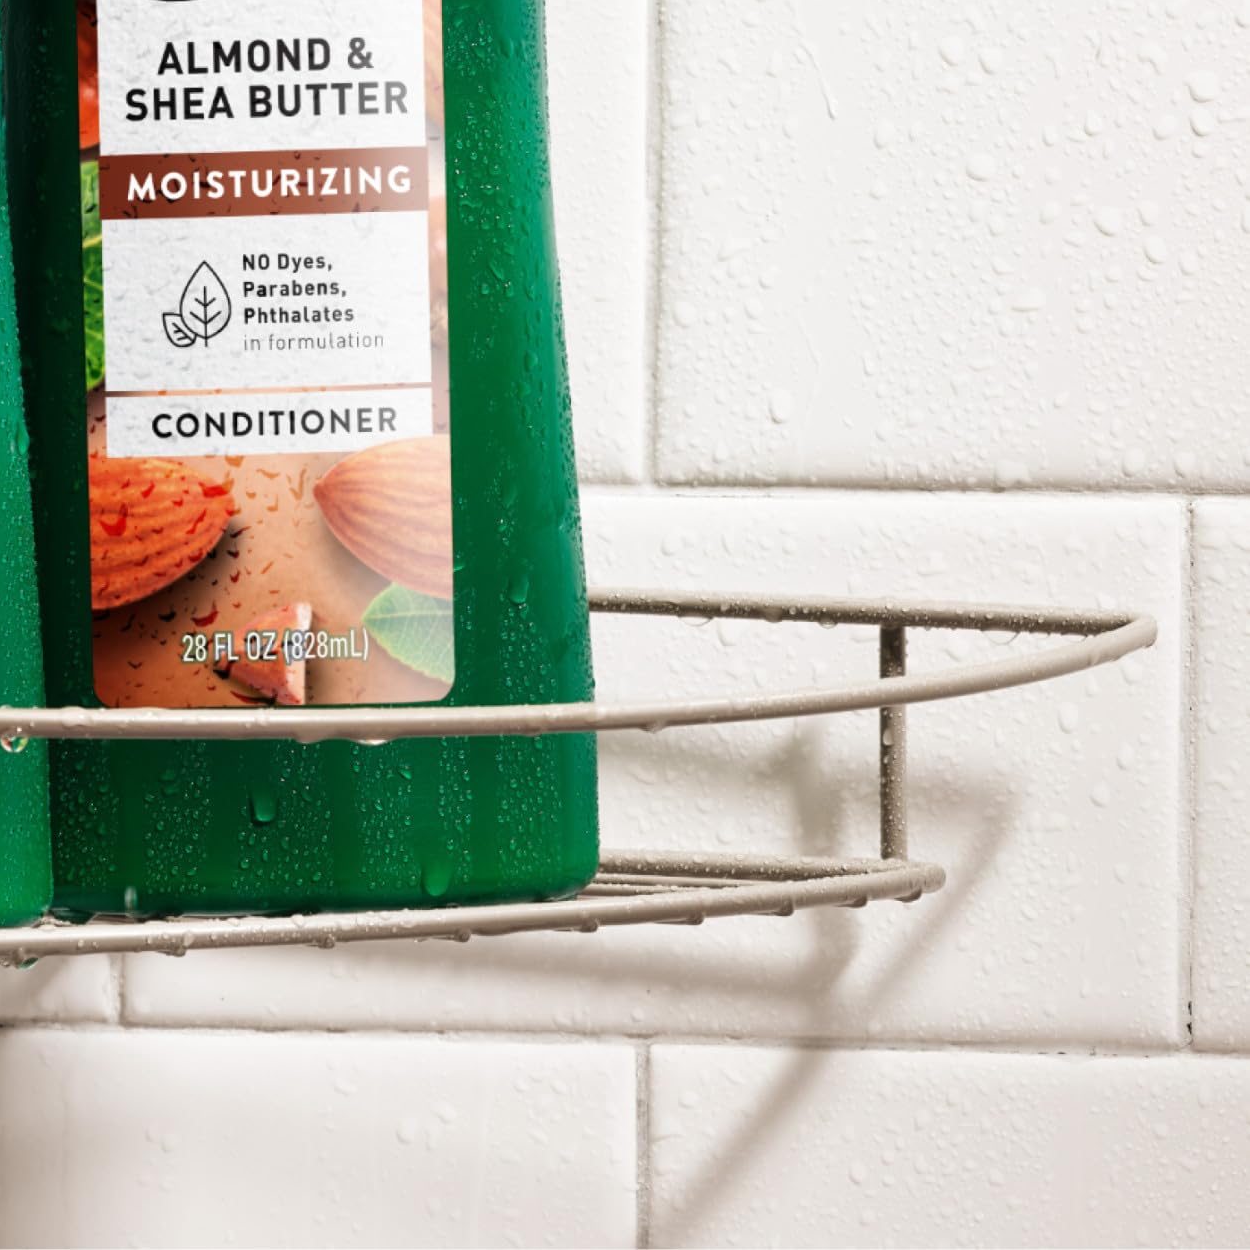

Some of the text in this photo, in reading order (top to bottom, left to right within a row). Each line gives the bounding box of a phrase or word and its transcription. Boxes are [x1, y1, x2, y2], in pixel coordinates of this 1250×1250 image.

[158, 38, 374, 75] ALMOND &
[126, 82, 408, 121] SHEA BUTTER
[127, 166, 411, 201] MOISTURIZING
[243, 254, 333, 273] NO Dyes,
[243, 281, 347, 297] Parabens,
[244, 307, 354, 324] Phthalates
[244, 332, 383, 350] in formulation
[152, 407, 397, 438] CONDITIONER
[182, 629, 370, 663] 28 FL OZ (828mL)
